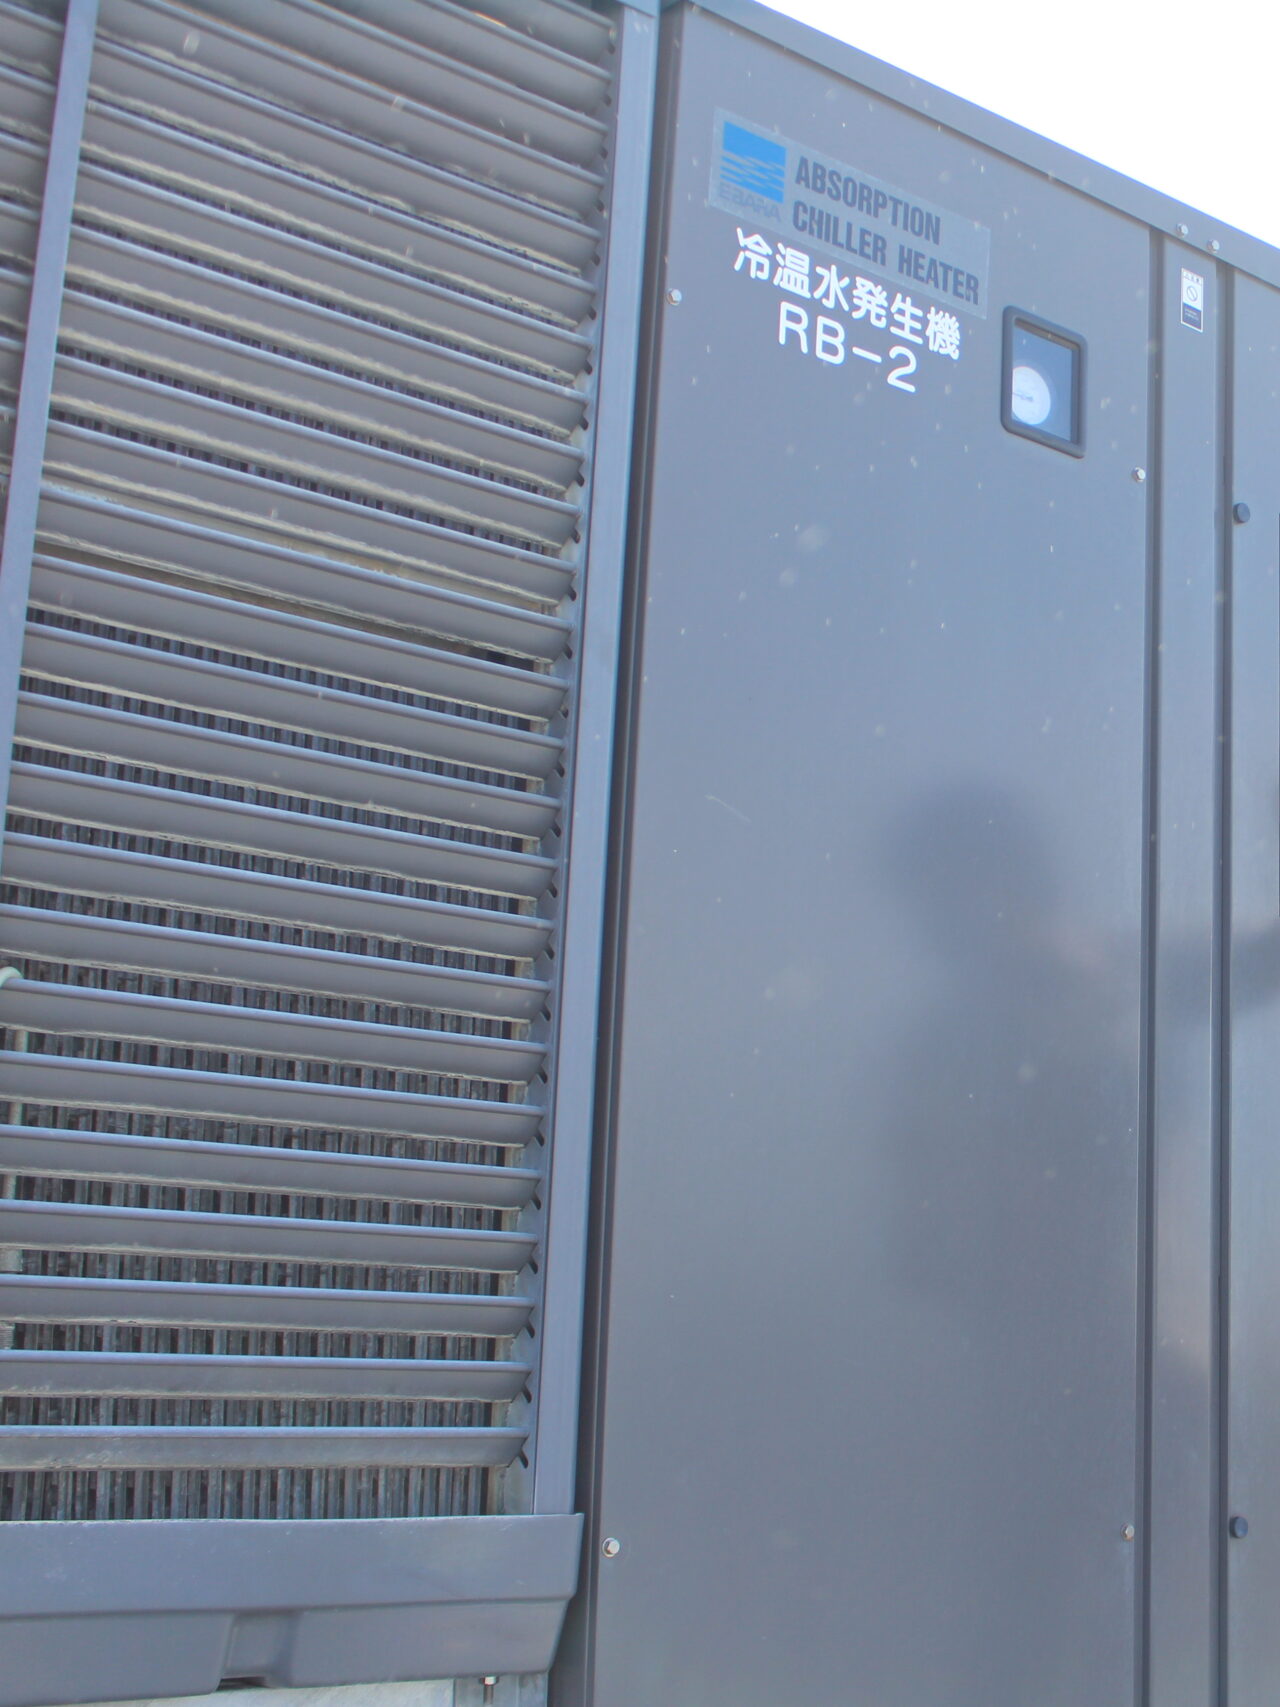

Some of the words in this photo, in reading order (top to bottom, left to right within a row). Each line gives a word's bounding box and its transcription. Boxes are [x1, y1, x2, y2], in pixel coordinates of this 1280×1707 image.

[792, 200, 888, 267] CHILLER
[898, 244, 980, 305] HEATER
[795, 156, 941, 246] ABSORPTION
[734, 227, 961, 360] 冷温水発生機
